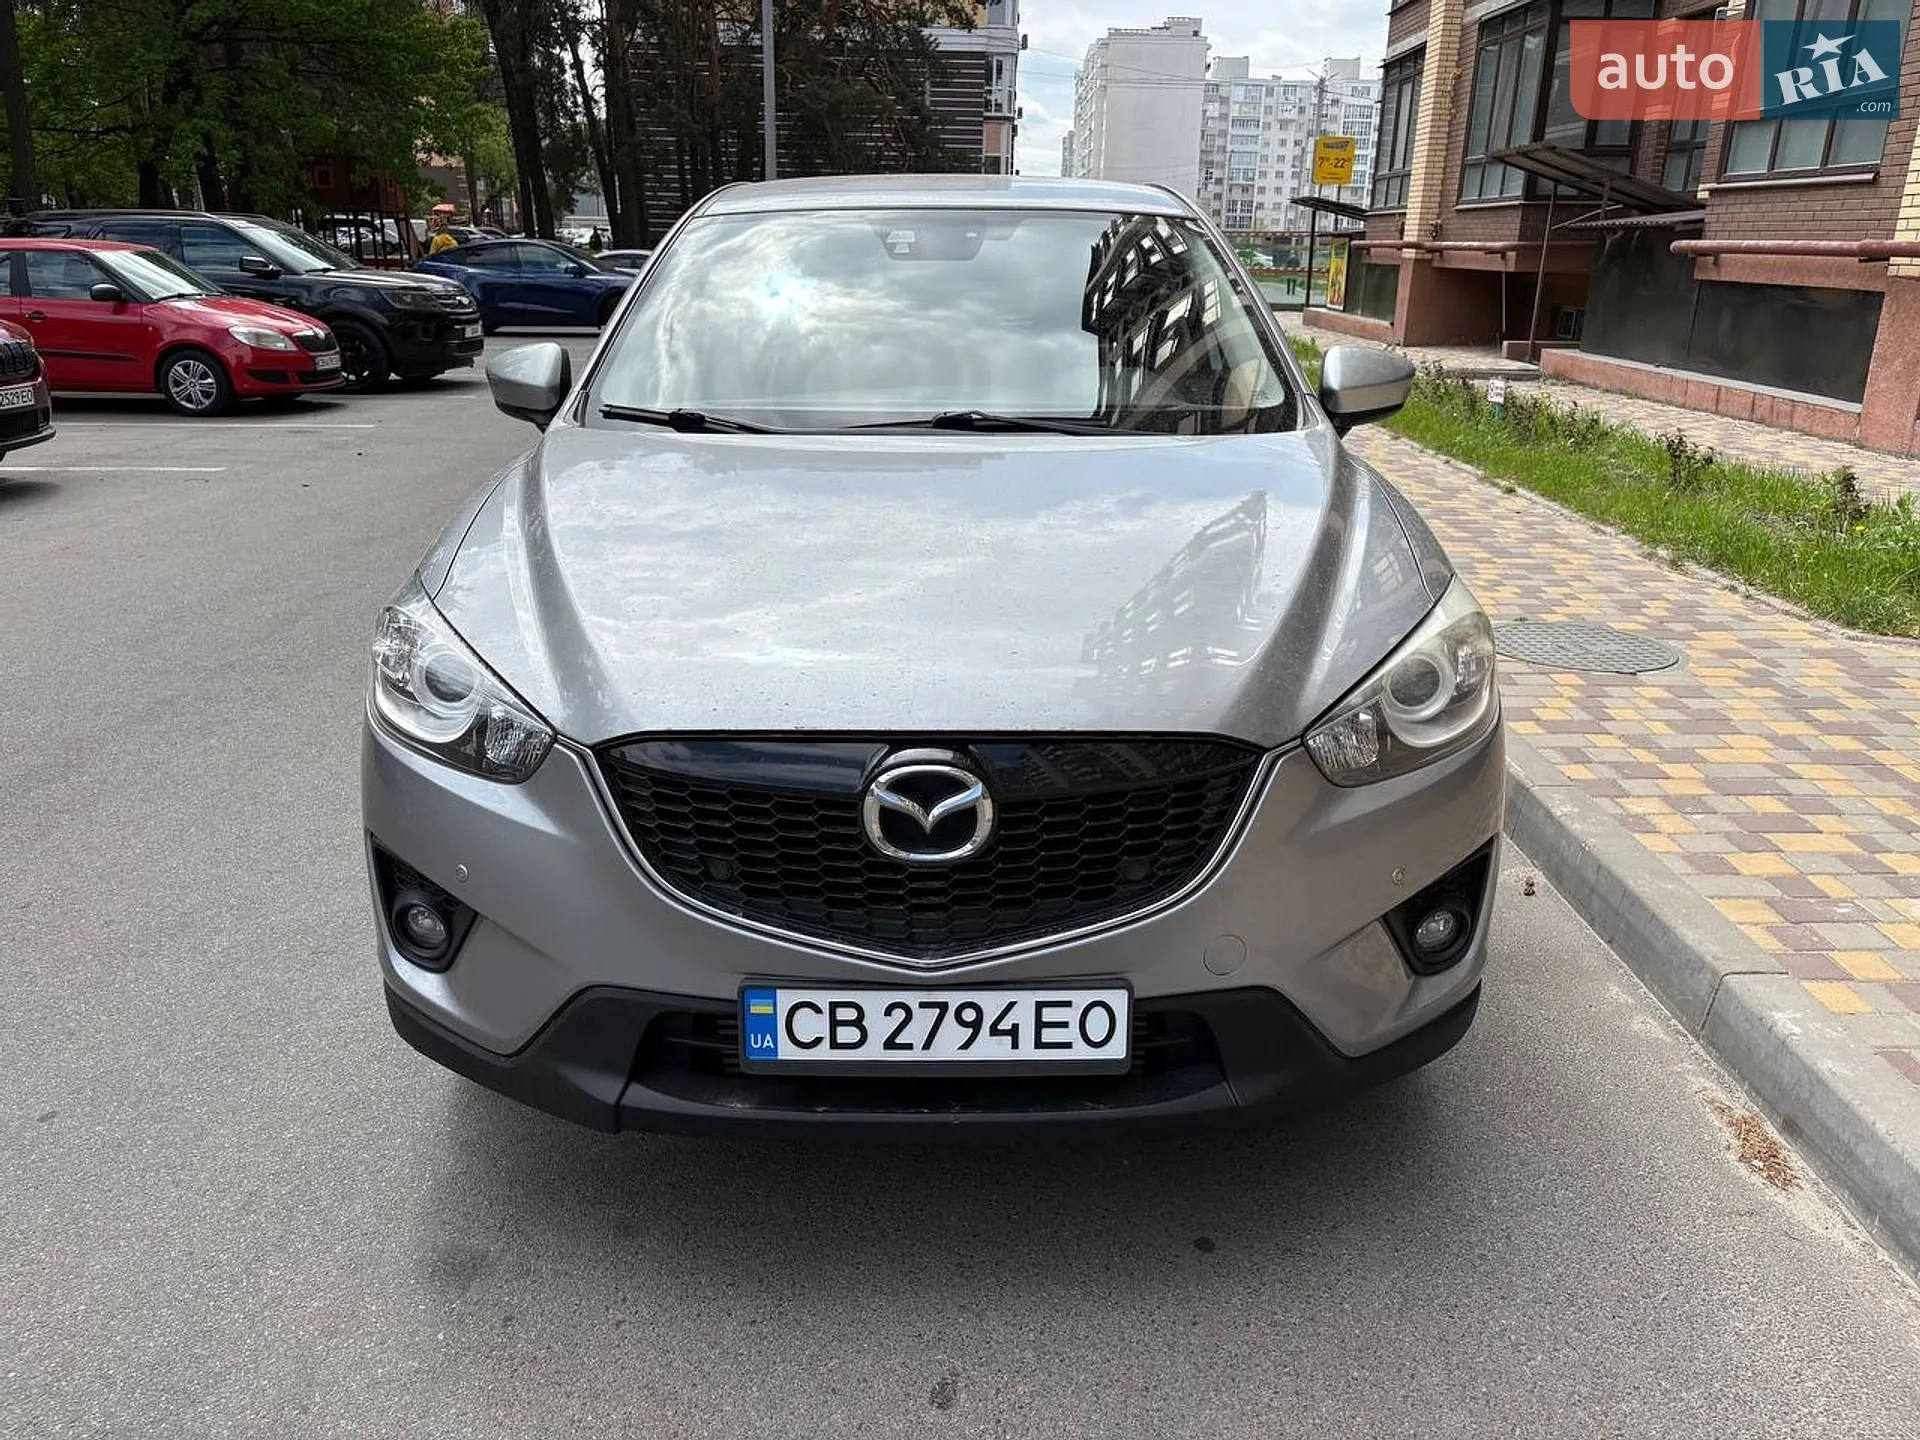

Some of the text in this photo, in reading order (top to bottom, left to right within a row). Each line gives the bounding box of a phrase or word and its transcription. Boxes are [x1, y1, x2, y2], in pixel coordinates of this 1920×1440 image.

[751, 1033, 775, 1049] UA
[784, 999, 1117, 1051] CB 2794 EO
